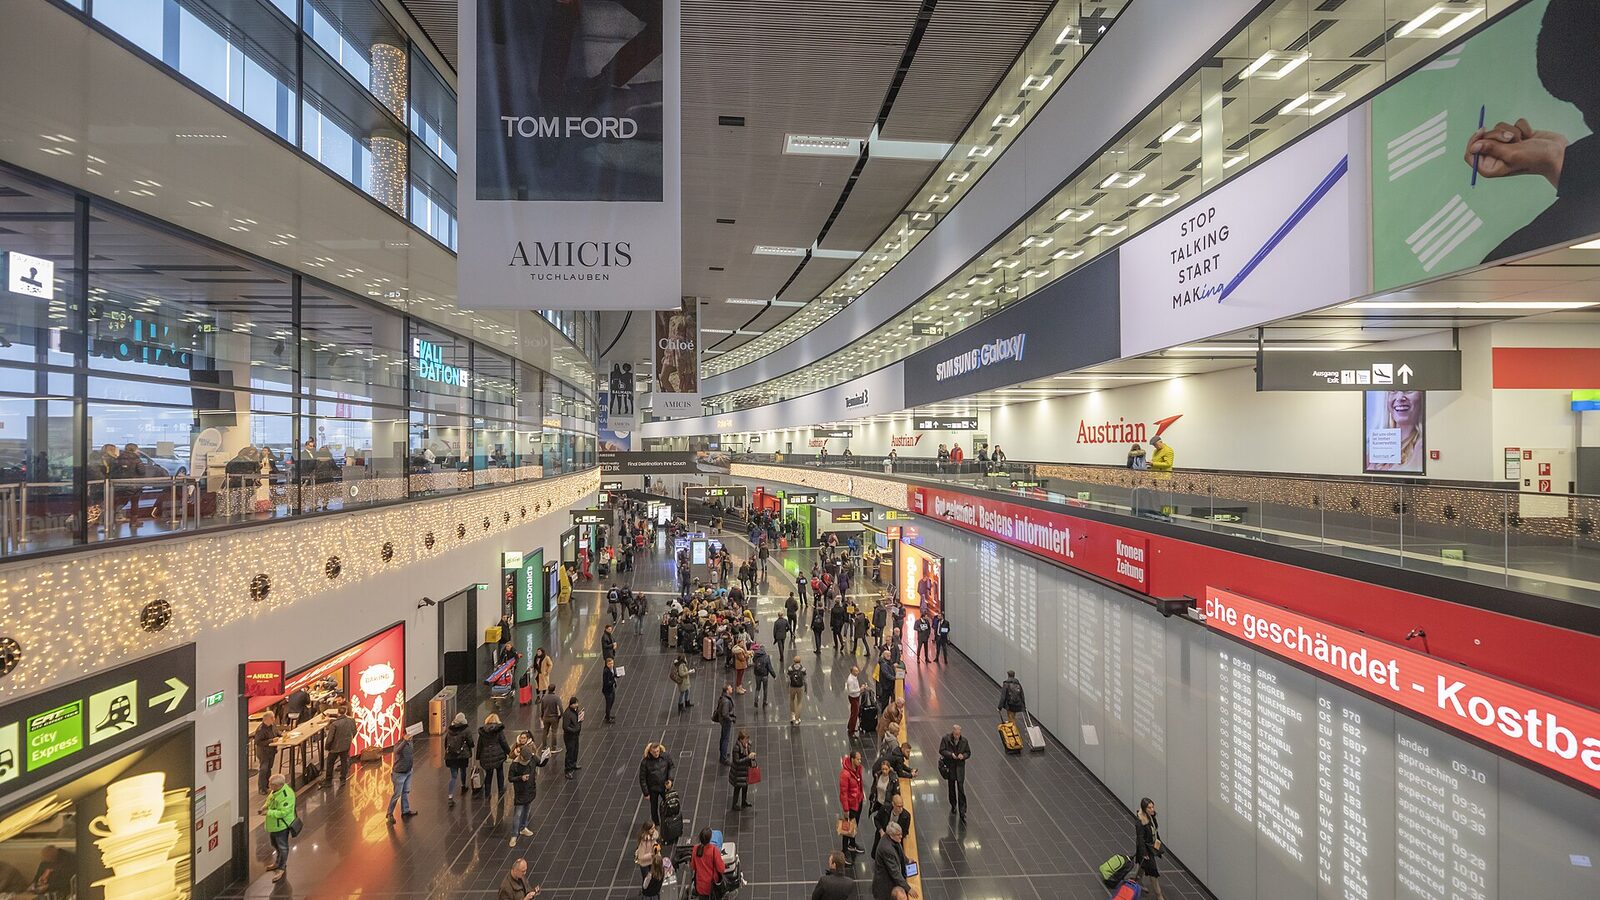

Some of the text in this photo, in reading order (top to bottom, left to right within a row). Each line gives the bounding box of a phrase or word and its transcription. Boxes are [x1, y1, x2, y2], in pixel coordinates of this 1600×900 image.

[501, 115, 638, 139] TOM FORD
[1181, 207, 1216, 237] STOP
[508, 241, 632, 267] AMICIS
[1171, 225, 1230, 264] TALKING
[530, 273, 610, 281] TUCHLAUBEN
[1179, 254, 1220, 284] START
[659, 338, 695, 350] Chloé
[936, 334, 1025, 381] SAMSUNG Galaxy
[1312, 370, 1339, 378] Ausgang
[1076, 417, 1147, 444] Austrian
[979, 505, 1013, 538] Bestens
[1015, 514, 1075, 559] informiert.
[1116, 539, 1144, 562] Kronen
[1116, 557, 1144, 583] Zeitung
[1243, 613, 1399, 691] geschändet
[1437, 674, 1600, 771] Kostba
[31, 730, 58, 747] City
[1233, 657, 1486, 784] 09:20 GRAZ OS 970 landed 09:10
[1257, 680, 1285, 700] ZAGREB
[1319, 711, 1332, 723] OS
[1398, 752, 1458, 790] approaching
[31, 735, 78, 762] Express
[1257, 692, 1302, 722] NUREMBERG
[1319, 723, 1333, 737] EW
[1398, 767, 1445, 798] expected
[1257, 704, 1286, 726] MUNICH
[1319, 737, 1332, 751] OS
[1343, 750, 1361, 767] 112
[1398, 782, 1445, 814] expected
[1257, 715, 1284, 737] LEIPZIG
[1319, 751, 1332, 764] OS
[1398, 797, 1458, 840] approaching
[1257, 727, 1294, 755] ISTANBUL
[1319, 763, 1331, 777] PC
[1398, 812, 1445, 847] expected
[1257, 739, 1279, 758] SOFIA
[1319, 777, 1332, 791] OE
[1398, 828, 1445, 863] expected
[1257, 751, 1294, 781] HANOVER
[1319, 789, 1333, 804] EW
[1398, 842, 1445, 879] expected
[1257, 798, 1303, 837] BARCELONA
[1257, 762, 1290, 790] HELSINKI
[1398, 858, 1445, 895] expected
[1257, 822, 1304, 862] FRANKFURT
[1319, 869, 1331, 885] LH
